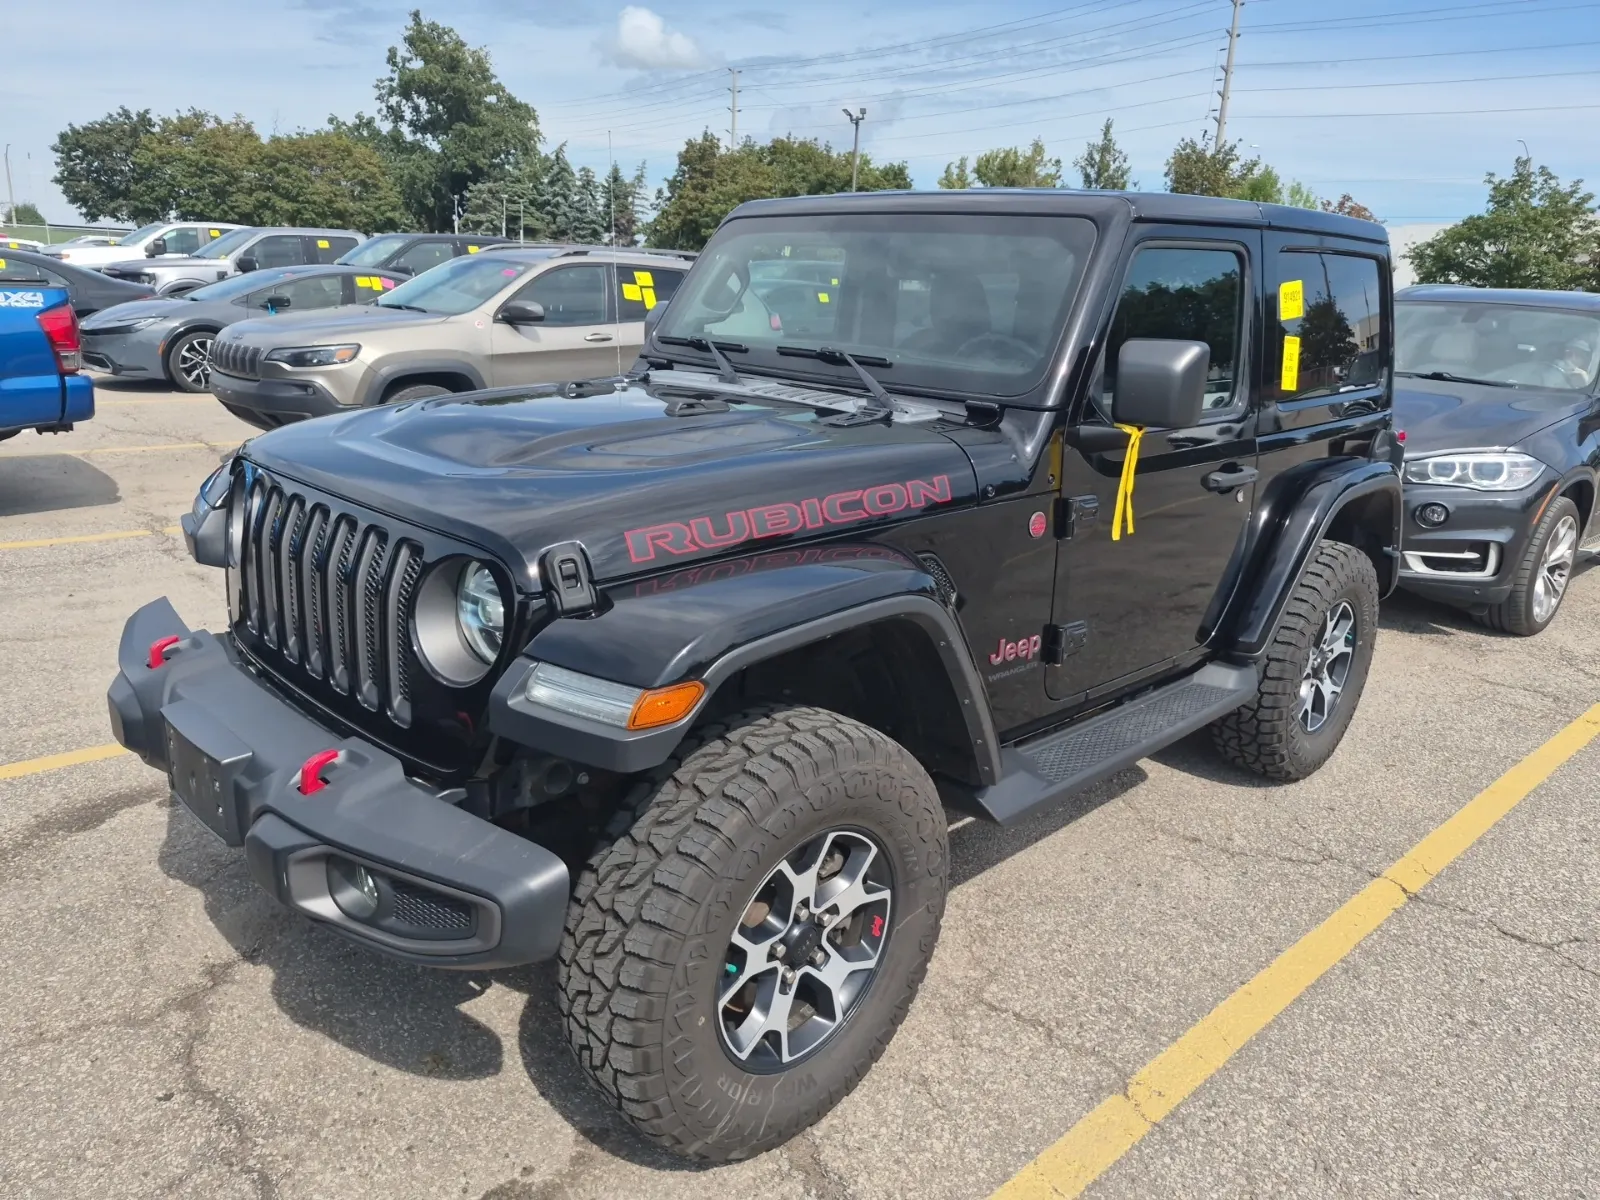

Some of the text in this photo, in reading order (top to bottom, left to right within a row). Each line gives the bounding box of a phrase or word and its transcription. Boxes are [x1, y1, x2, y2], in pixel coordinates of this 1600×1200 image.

[0, 292, 44, 302] X4
[624, 475, 951, 562] RUBICON
[989, 634, 1041, 665] Jeep
[716, 1072, 818, 1107] WRIOR
